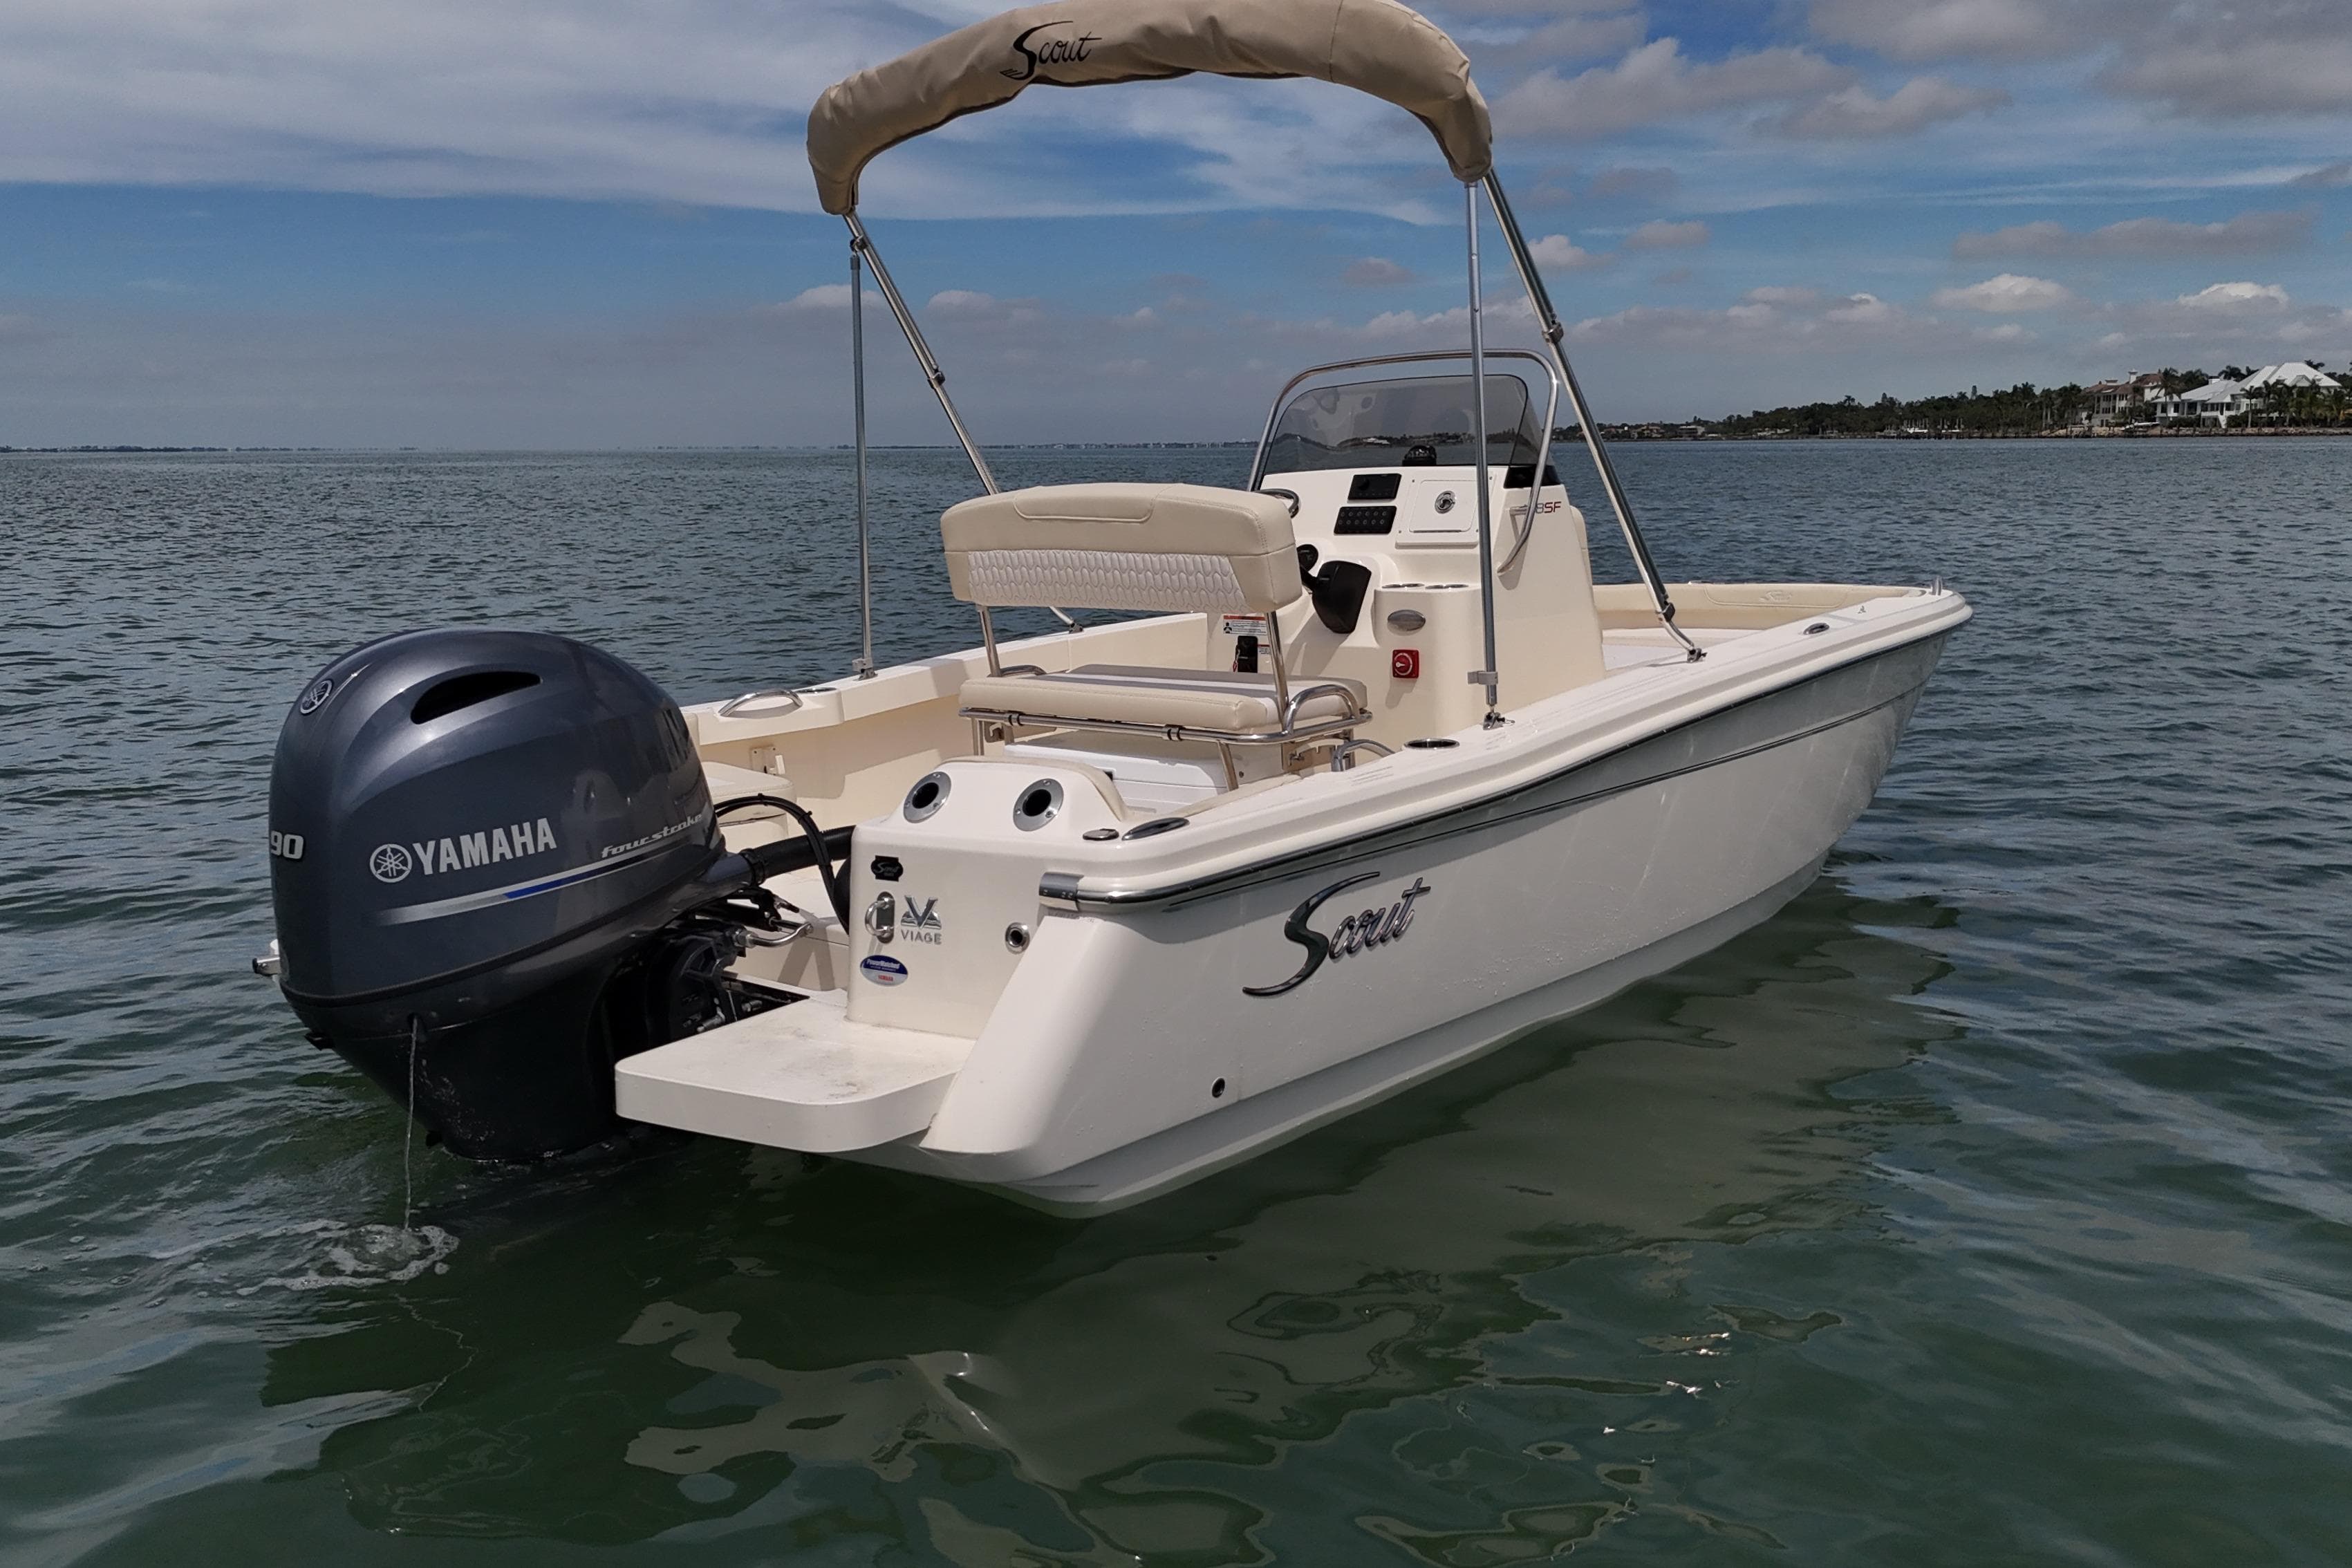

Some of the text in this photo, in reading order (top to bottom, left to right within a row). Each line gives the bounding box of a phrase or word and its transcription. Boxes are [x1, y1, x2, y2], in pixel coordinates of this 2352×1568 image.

[1000, 20, 1103, 80] Scout
[270, 830, 304, 859] 90
[412, 817, 557, 875] YAMAHA
[901, 929, 942, 944] VIAGE
[1242, 871, 1431, 996] Scout
